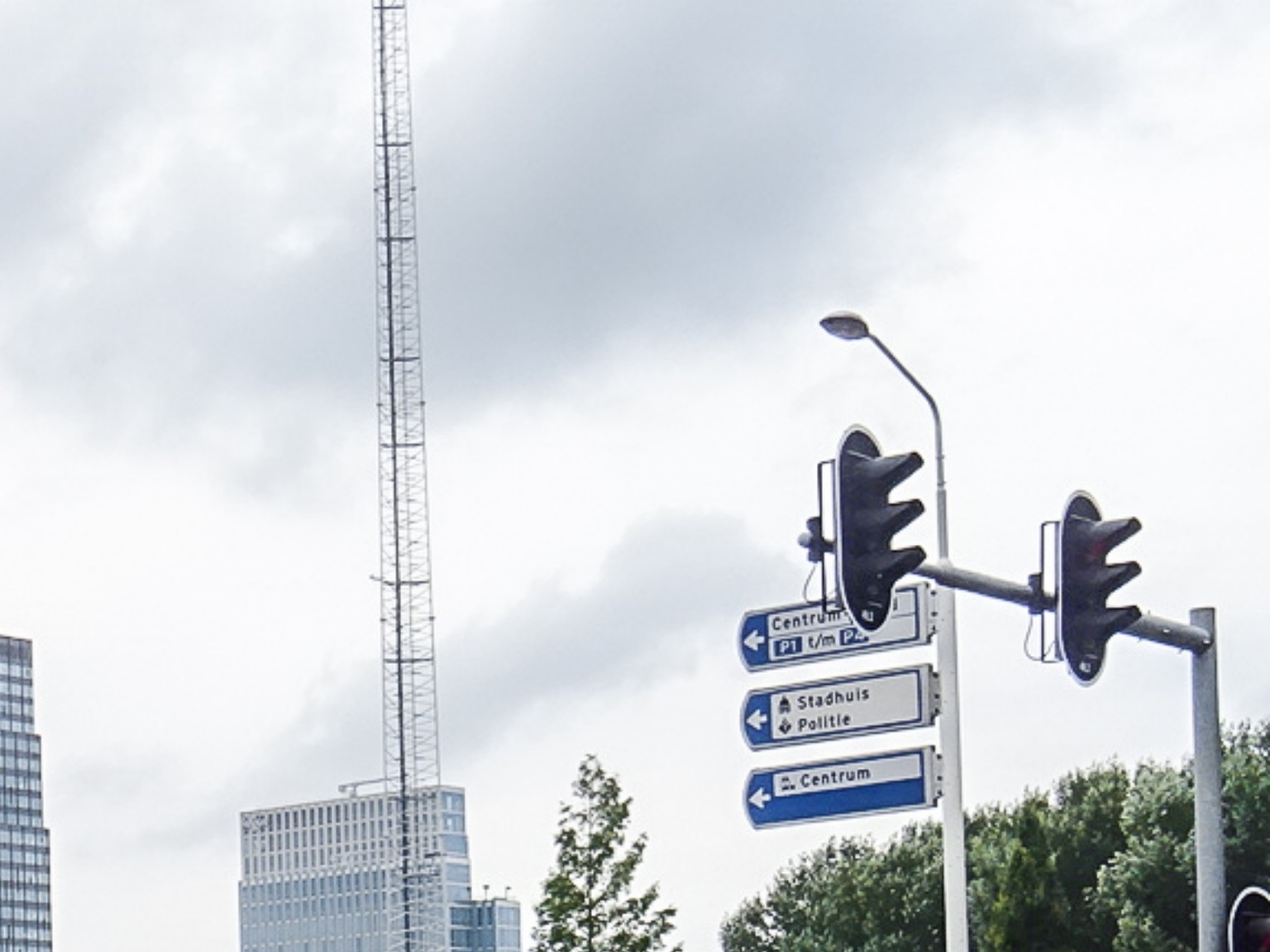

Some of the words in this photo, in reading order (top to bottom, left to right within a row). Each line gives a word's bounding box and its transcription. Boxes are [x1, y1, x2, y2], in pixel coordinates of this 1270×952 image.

[781, 641, 797, 653] P1
[808, 633, 836, 648] t/m
[797, 688, 870, 710] Stadhuis
[798, 716, 851, 732] Politie
[800, 768, 871, 788] Centrum
